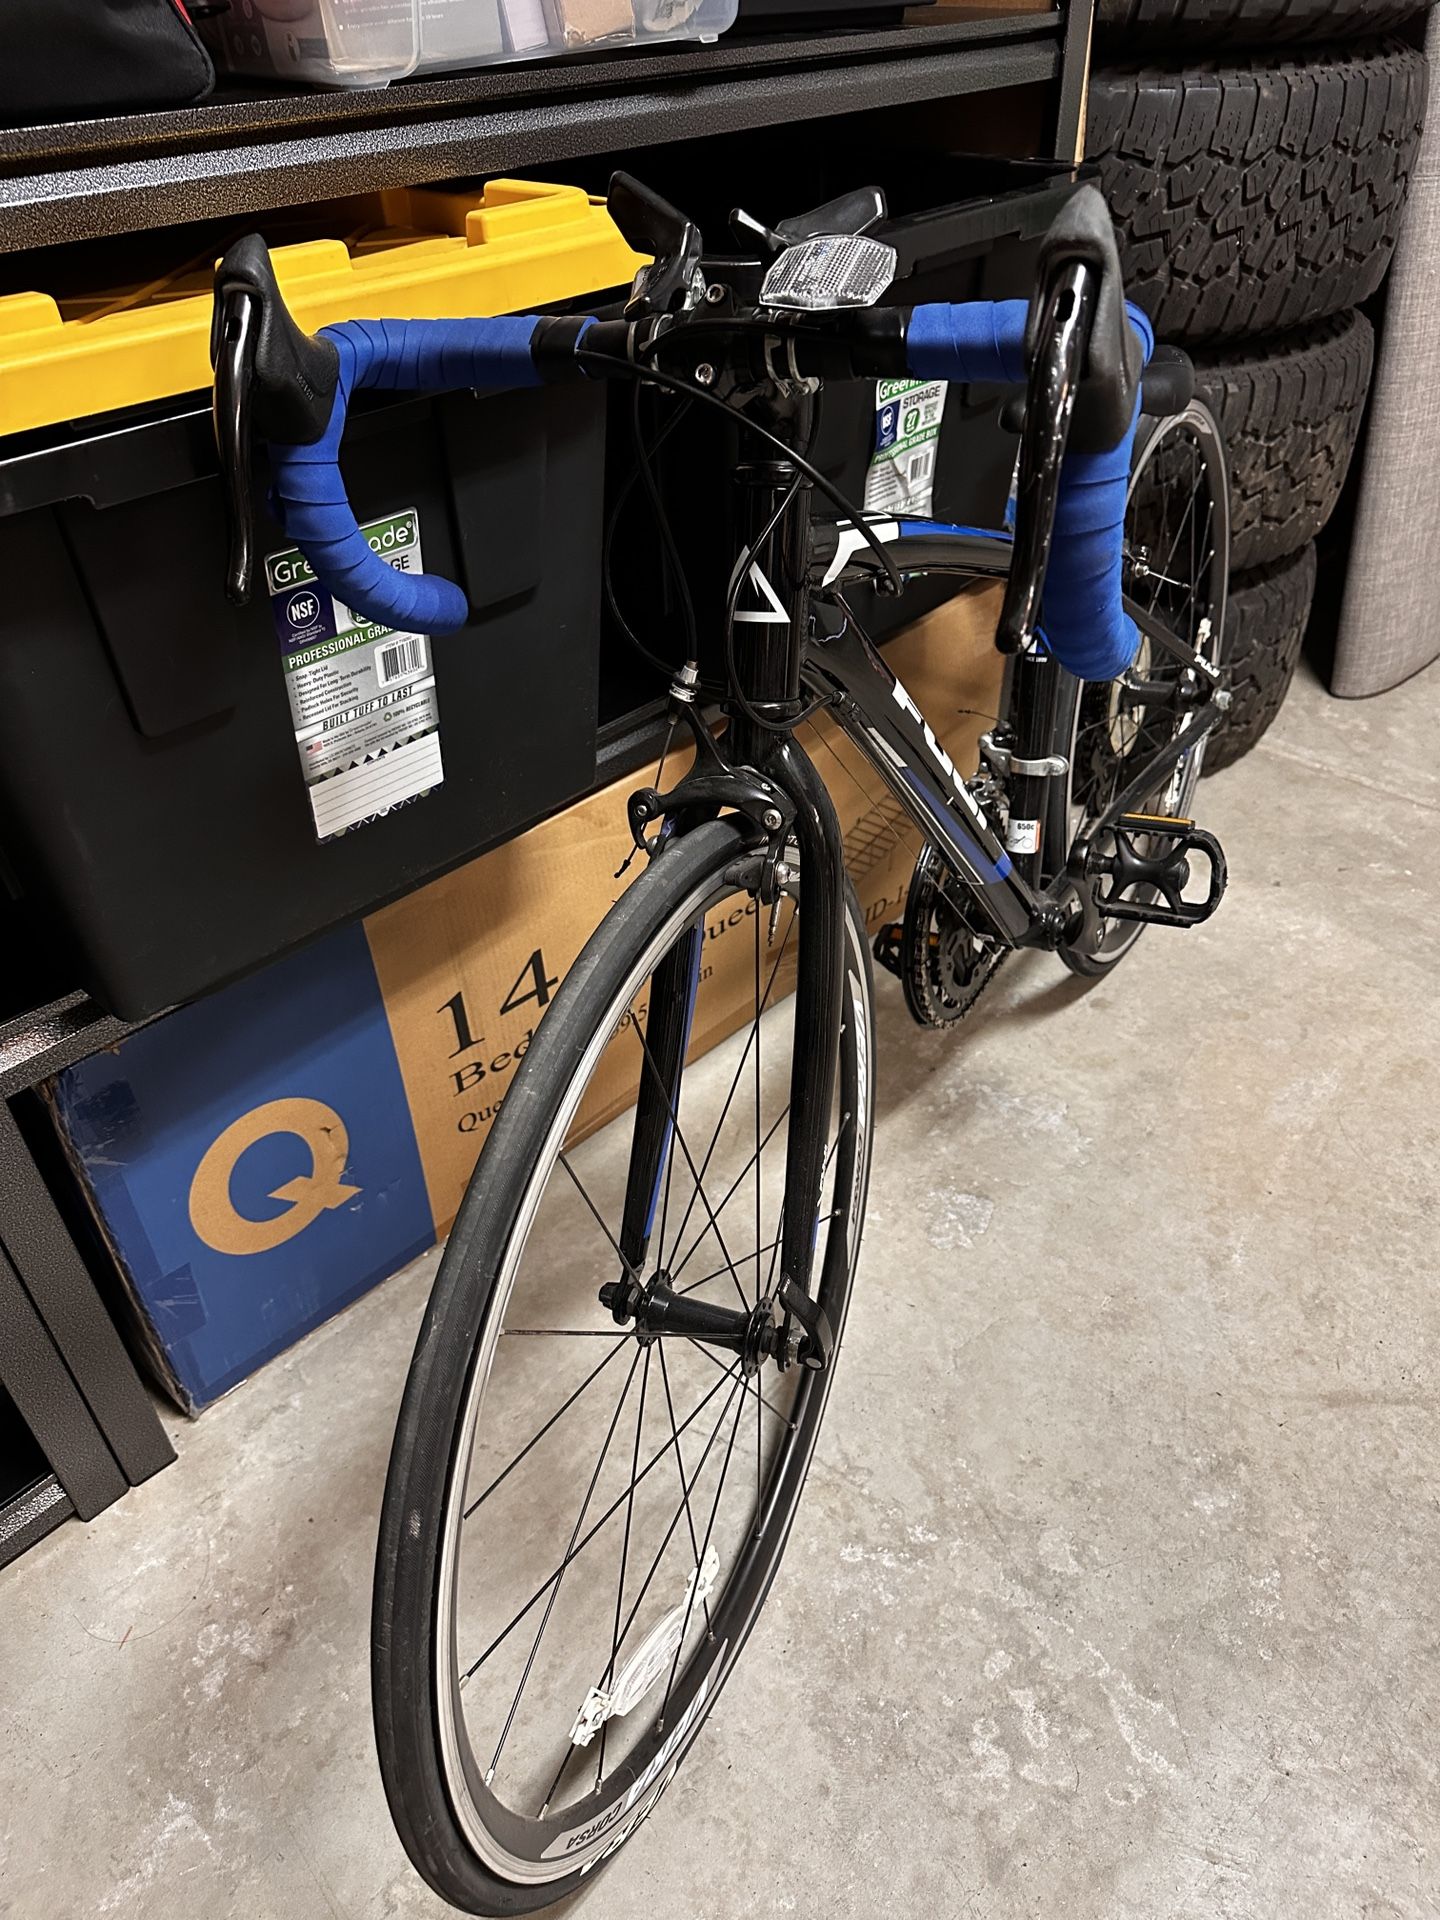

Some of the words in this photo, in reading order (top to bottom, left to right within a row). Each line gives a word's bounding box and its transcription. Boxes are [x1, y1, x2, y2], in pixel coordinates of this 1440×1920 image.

[903, 386, 941, 409] STORAGE
[906, 411, 917, 427] 27
[291, 599, 314, 621] NSF
[288, 633, 366, 669] PROFESSIONAL
[299, 686, 320, 697] Designed
[351, 666, 371, 676] Durability
[324, 670, 339, 679] Plastic
[300, 691, 324, 705] Reinforced
[325, 682, 352, 695] Construction
[340, 695, 359, 706] Stacking
[341, 687, 359, 698] Security
[406, 697, 430, 711] RECYCLABLE
[322, 712, 350, 731] BUILT
[353, 703, 374, 718] TUFF
[378, 696, 388, 708] TO
[392, 685, 413, 702] LAST
[1017, 822, 1035, 830] 650c
[436, 948, 559, 1060] 14
[189, 1097, 363, 1255] Q
[566, 1802, 623, 1850] CORSA
